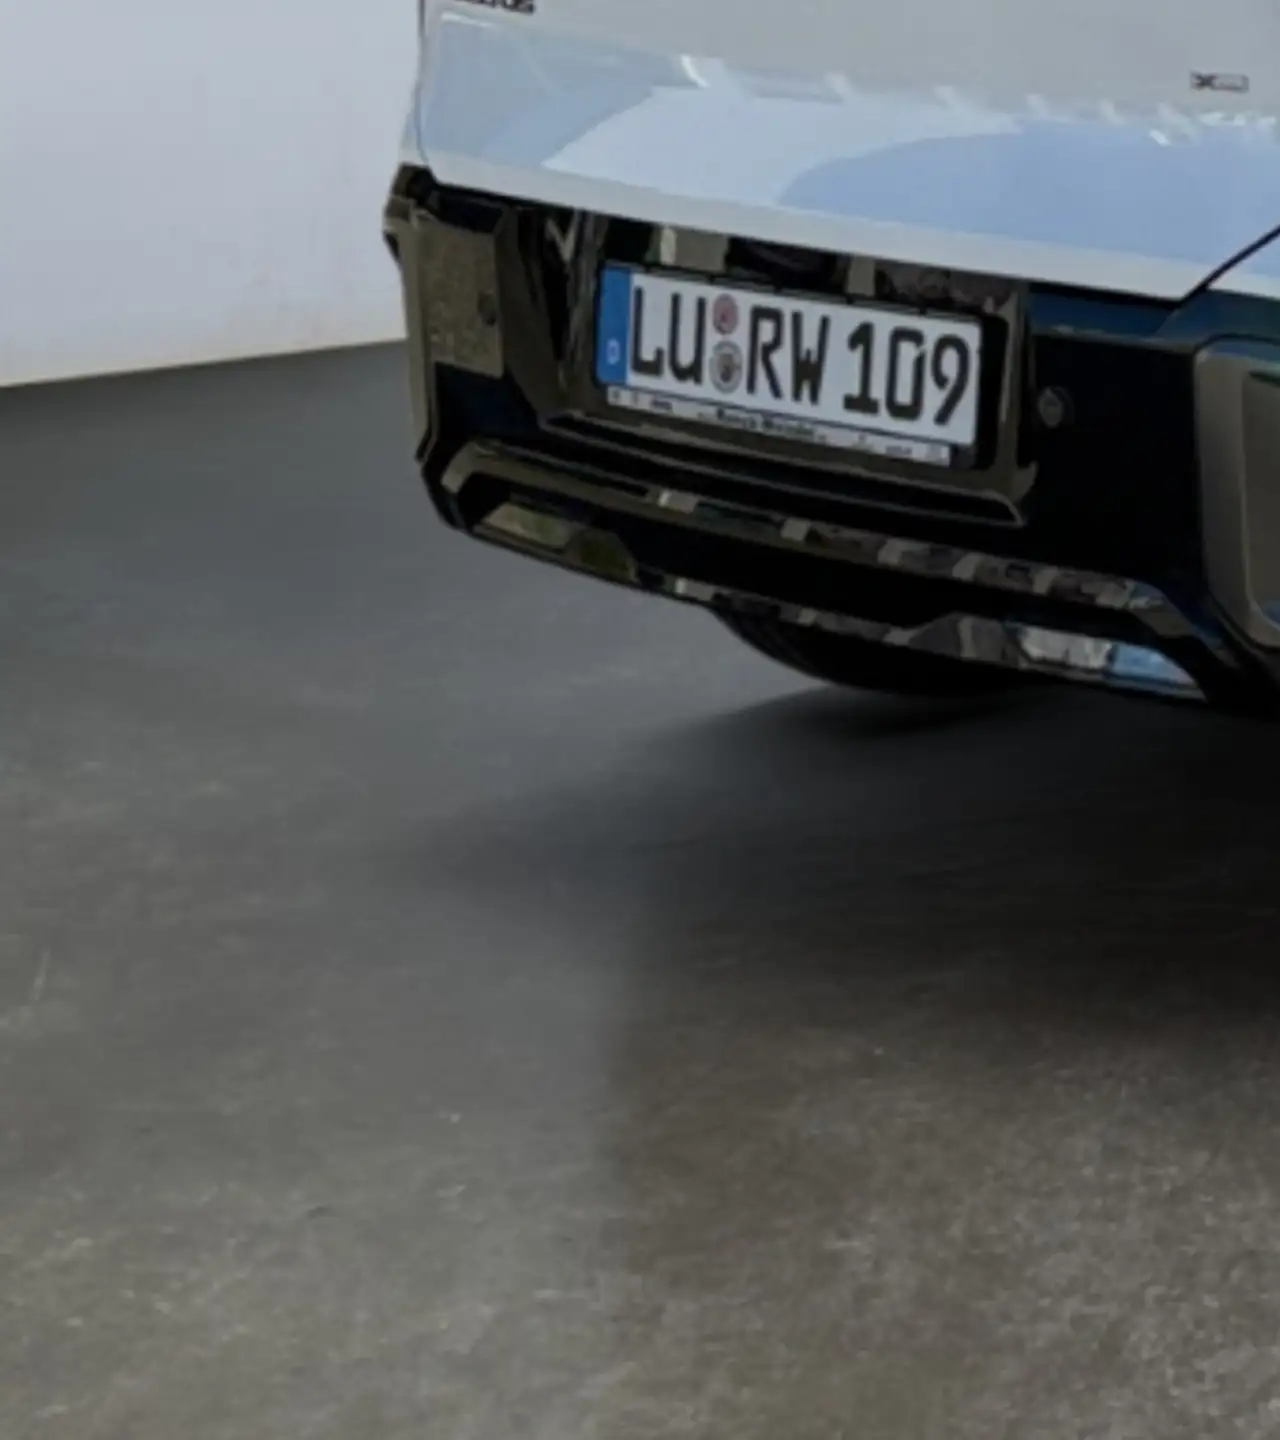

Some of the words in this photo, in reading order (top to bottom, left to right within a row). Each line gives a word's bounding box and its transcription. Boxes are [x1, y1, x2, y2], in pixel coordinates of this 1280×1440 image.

[630, 286, 706, 388] LU
[745, 305, 832, 407] RW
[842, 320, 972, 427] 109
